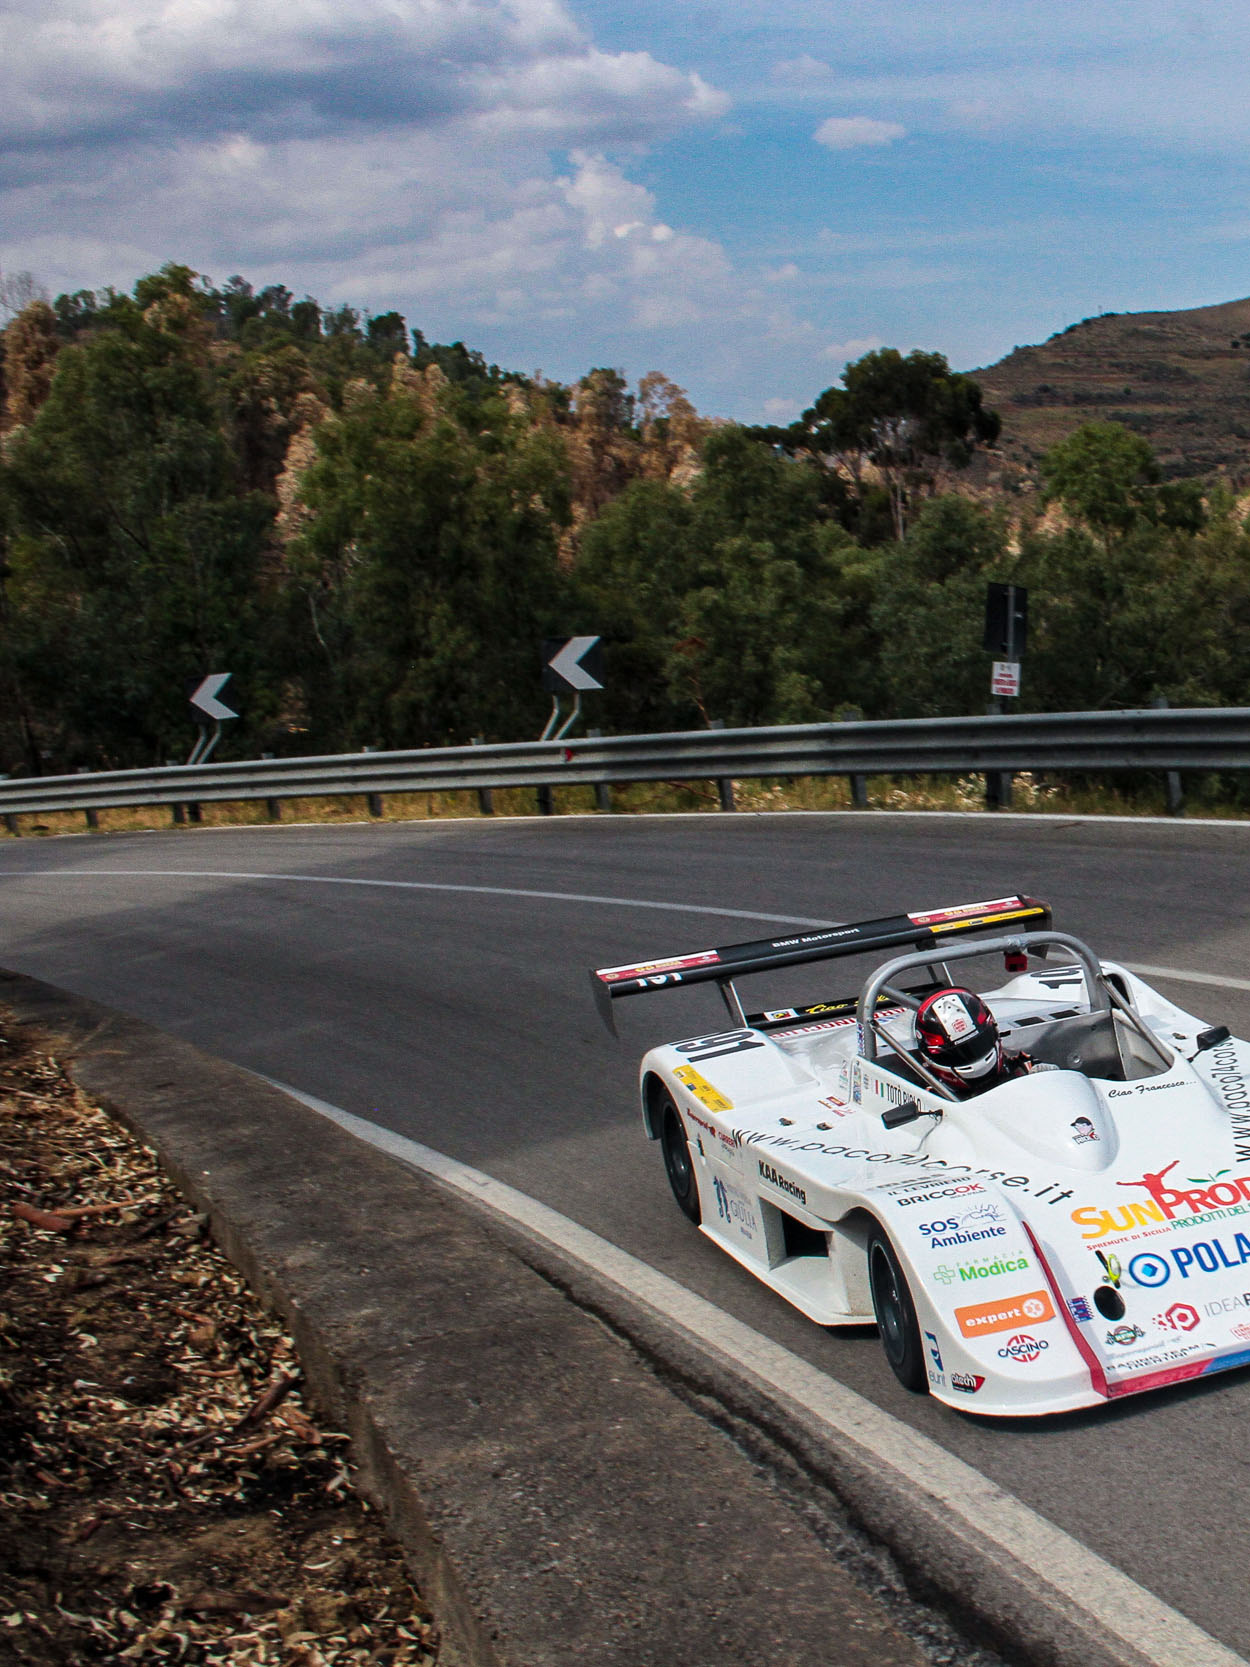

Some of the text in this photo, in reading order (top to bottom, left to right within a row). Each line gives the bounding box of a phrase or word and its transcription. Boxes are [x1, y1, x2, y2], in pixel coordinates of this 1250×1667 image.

[771, 928, 860, 948] BMW Motorsport
[1108, 1089, 1133, 1098] Ciao
[759, 1160, 778, 1186] KAA
[778, 1174, 807, 1205] Racing
[919, 1218, 959, 1235] SOS
[1170, 1210, 1227, 1230] PRODOTTI
[1228, 1205, 1248, 1217] DEL
[931, 1226, 1007, 1249] Ambiente
[959, 1257, 1029, 1281] Modica
[965, 1308, 1022, 1327] expert
[998, 1340, 1049, 1358] CASCINO
